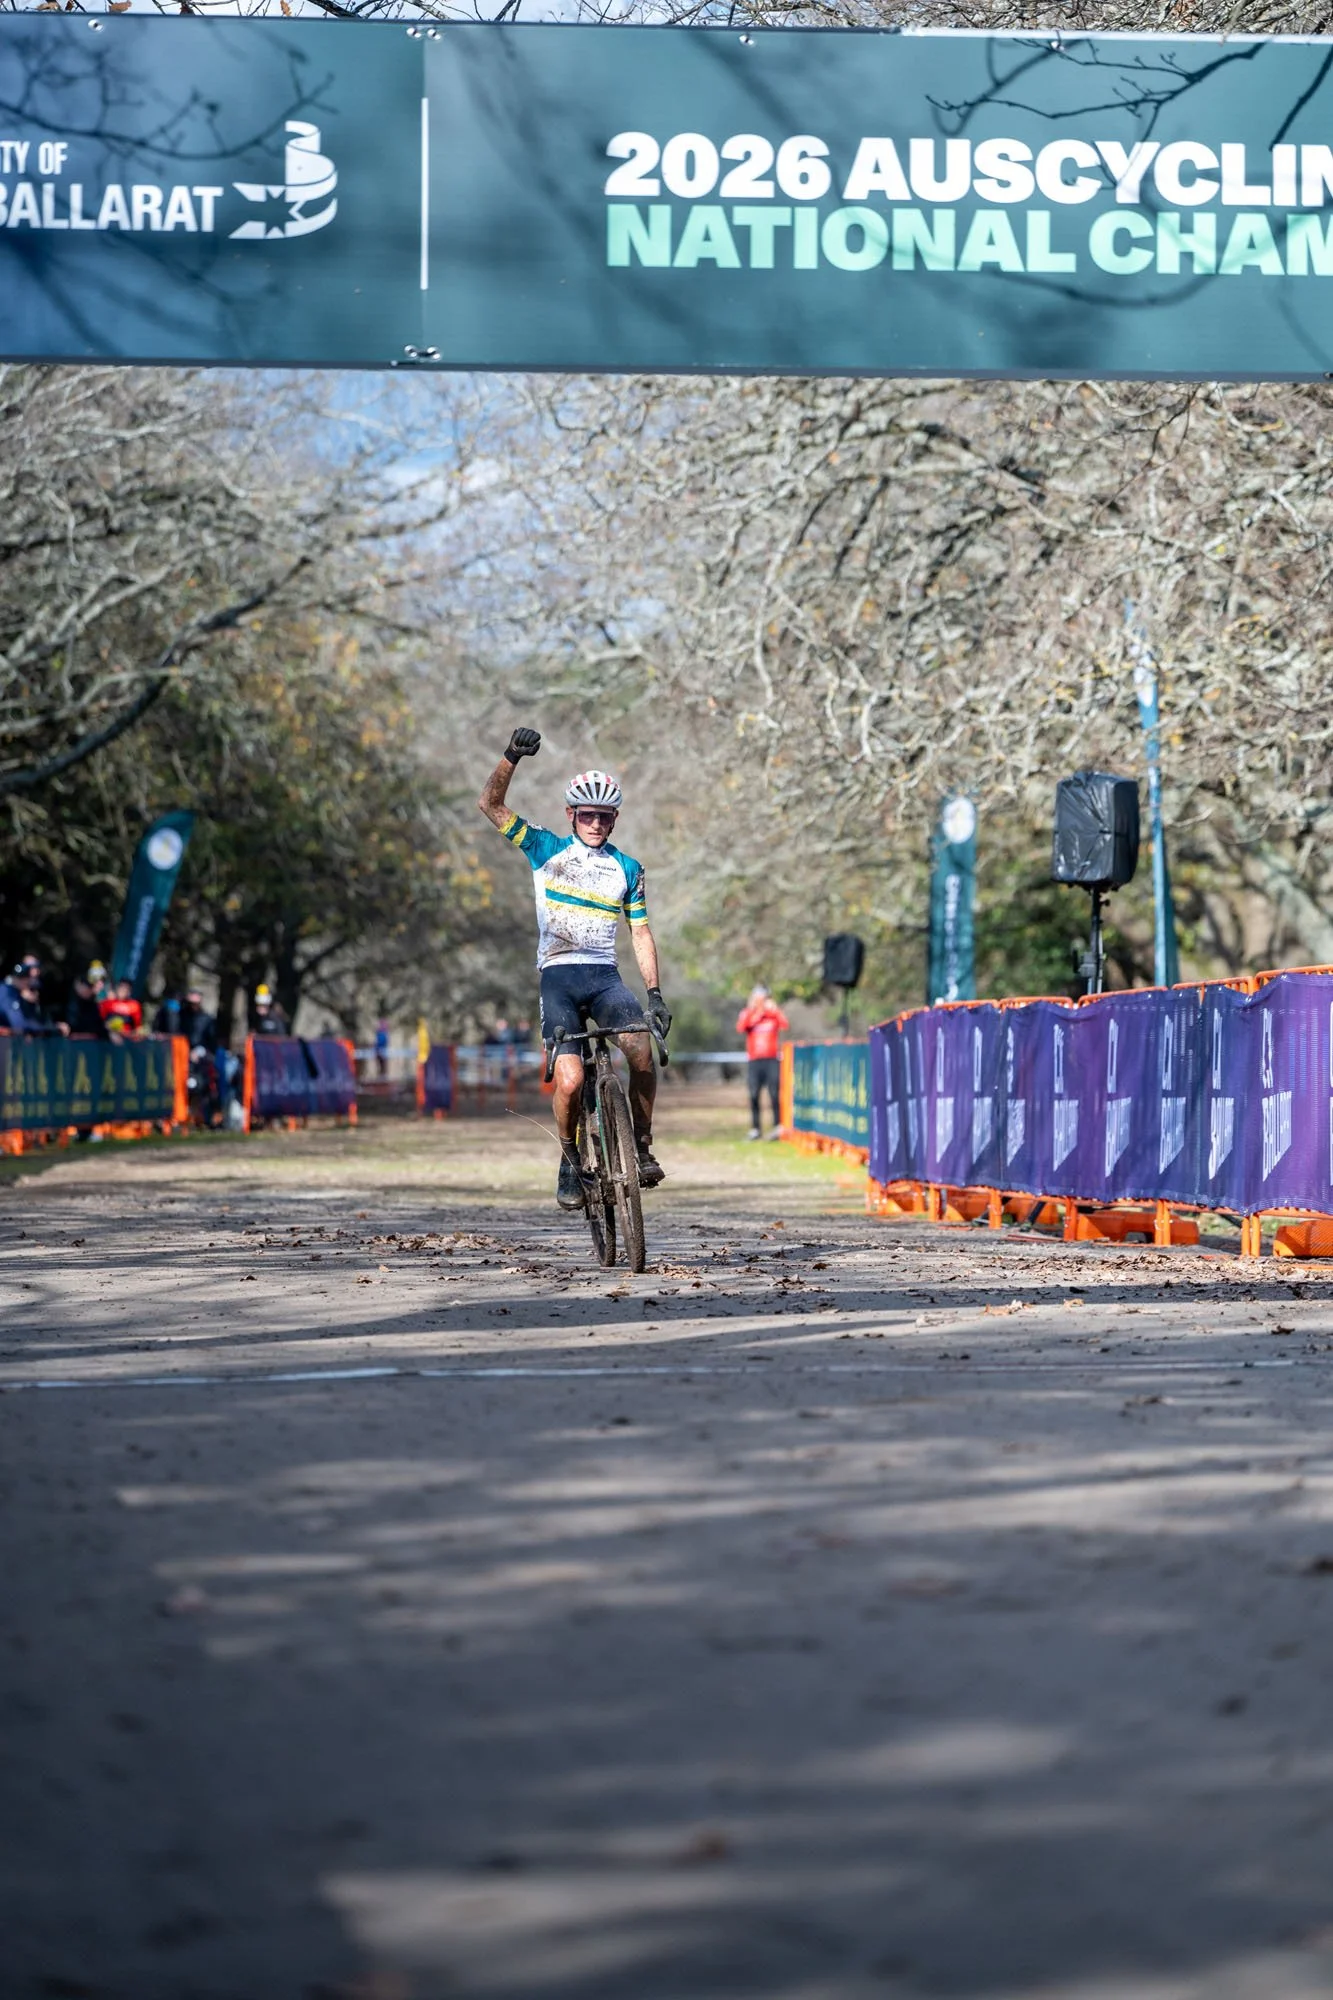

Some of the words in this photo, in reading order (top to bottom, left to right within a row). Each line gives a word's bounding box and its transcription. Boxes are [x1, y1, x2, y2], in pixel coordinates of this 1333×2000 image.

[38, 141, 68, 175] OF
[604, 131, 832, 201] 2026
[0, 182, 224, 232] ALLARAT
[607, 203, 1077, 273] NATIONAL
[1088, 210, 1333, 277] CHAM
